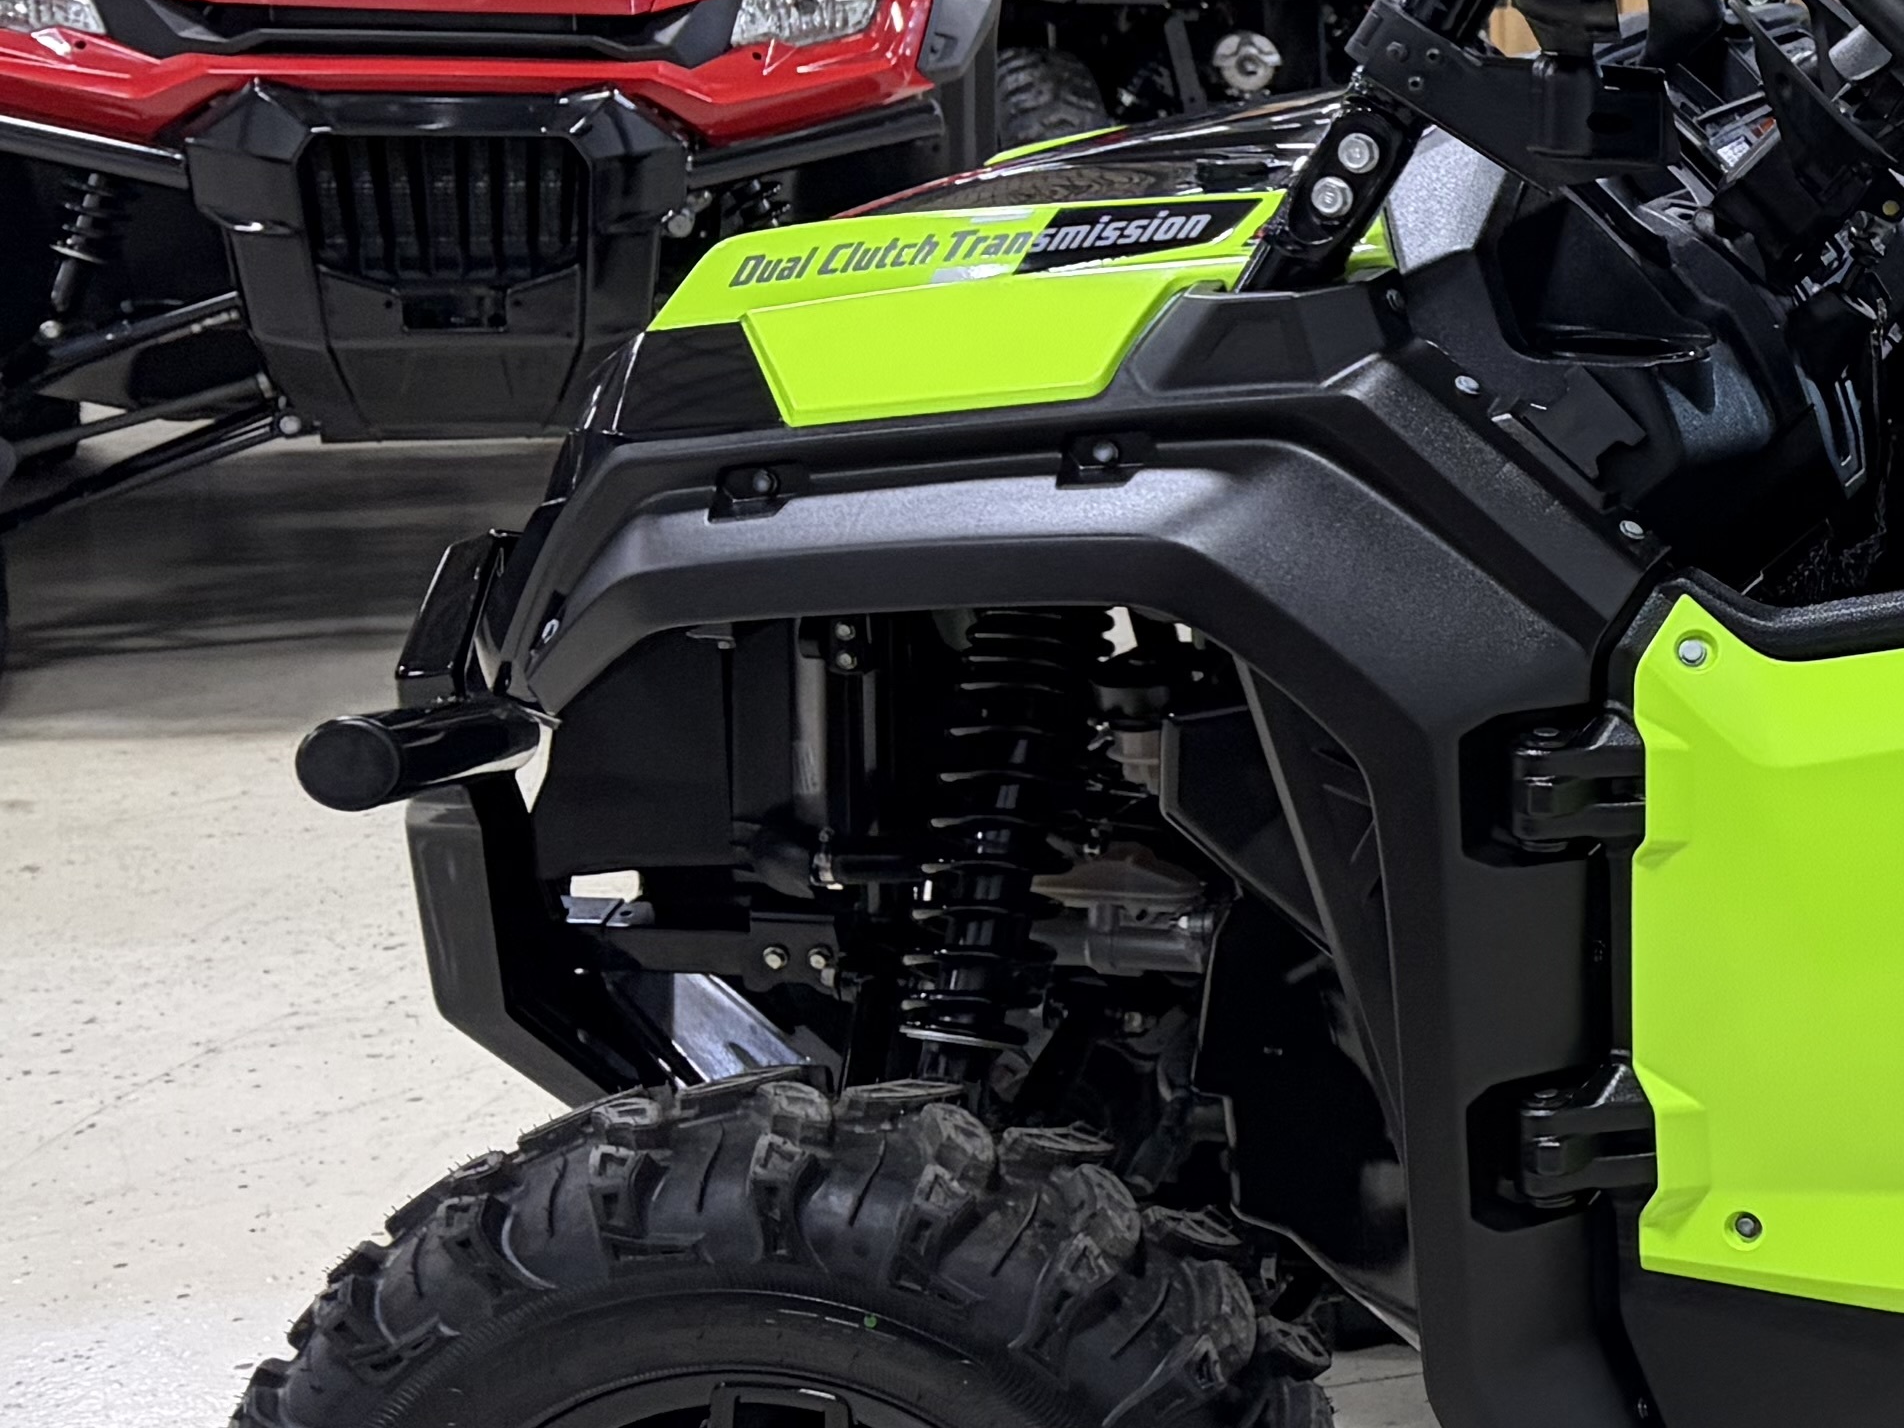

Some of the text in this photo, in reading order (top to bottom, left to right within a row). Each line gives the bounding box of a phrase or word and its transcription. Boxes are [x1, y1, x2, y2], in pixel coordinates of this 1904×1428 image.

[728, 208, 1212, 289] Dual Clutch Transmission
